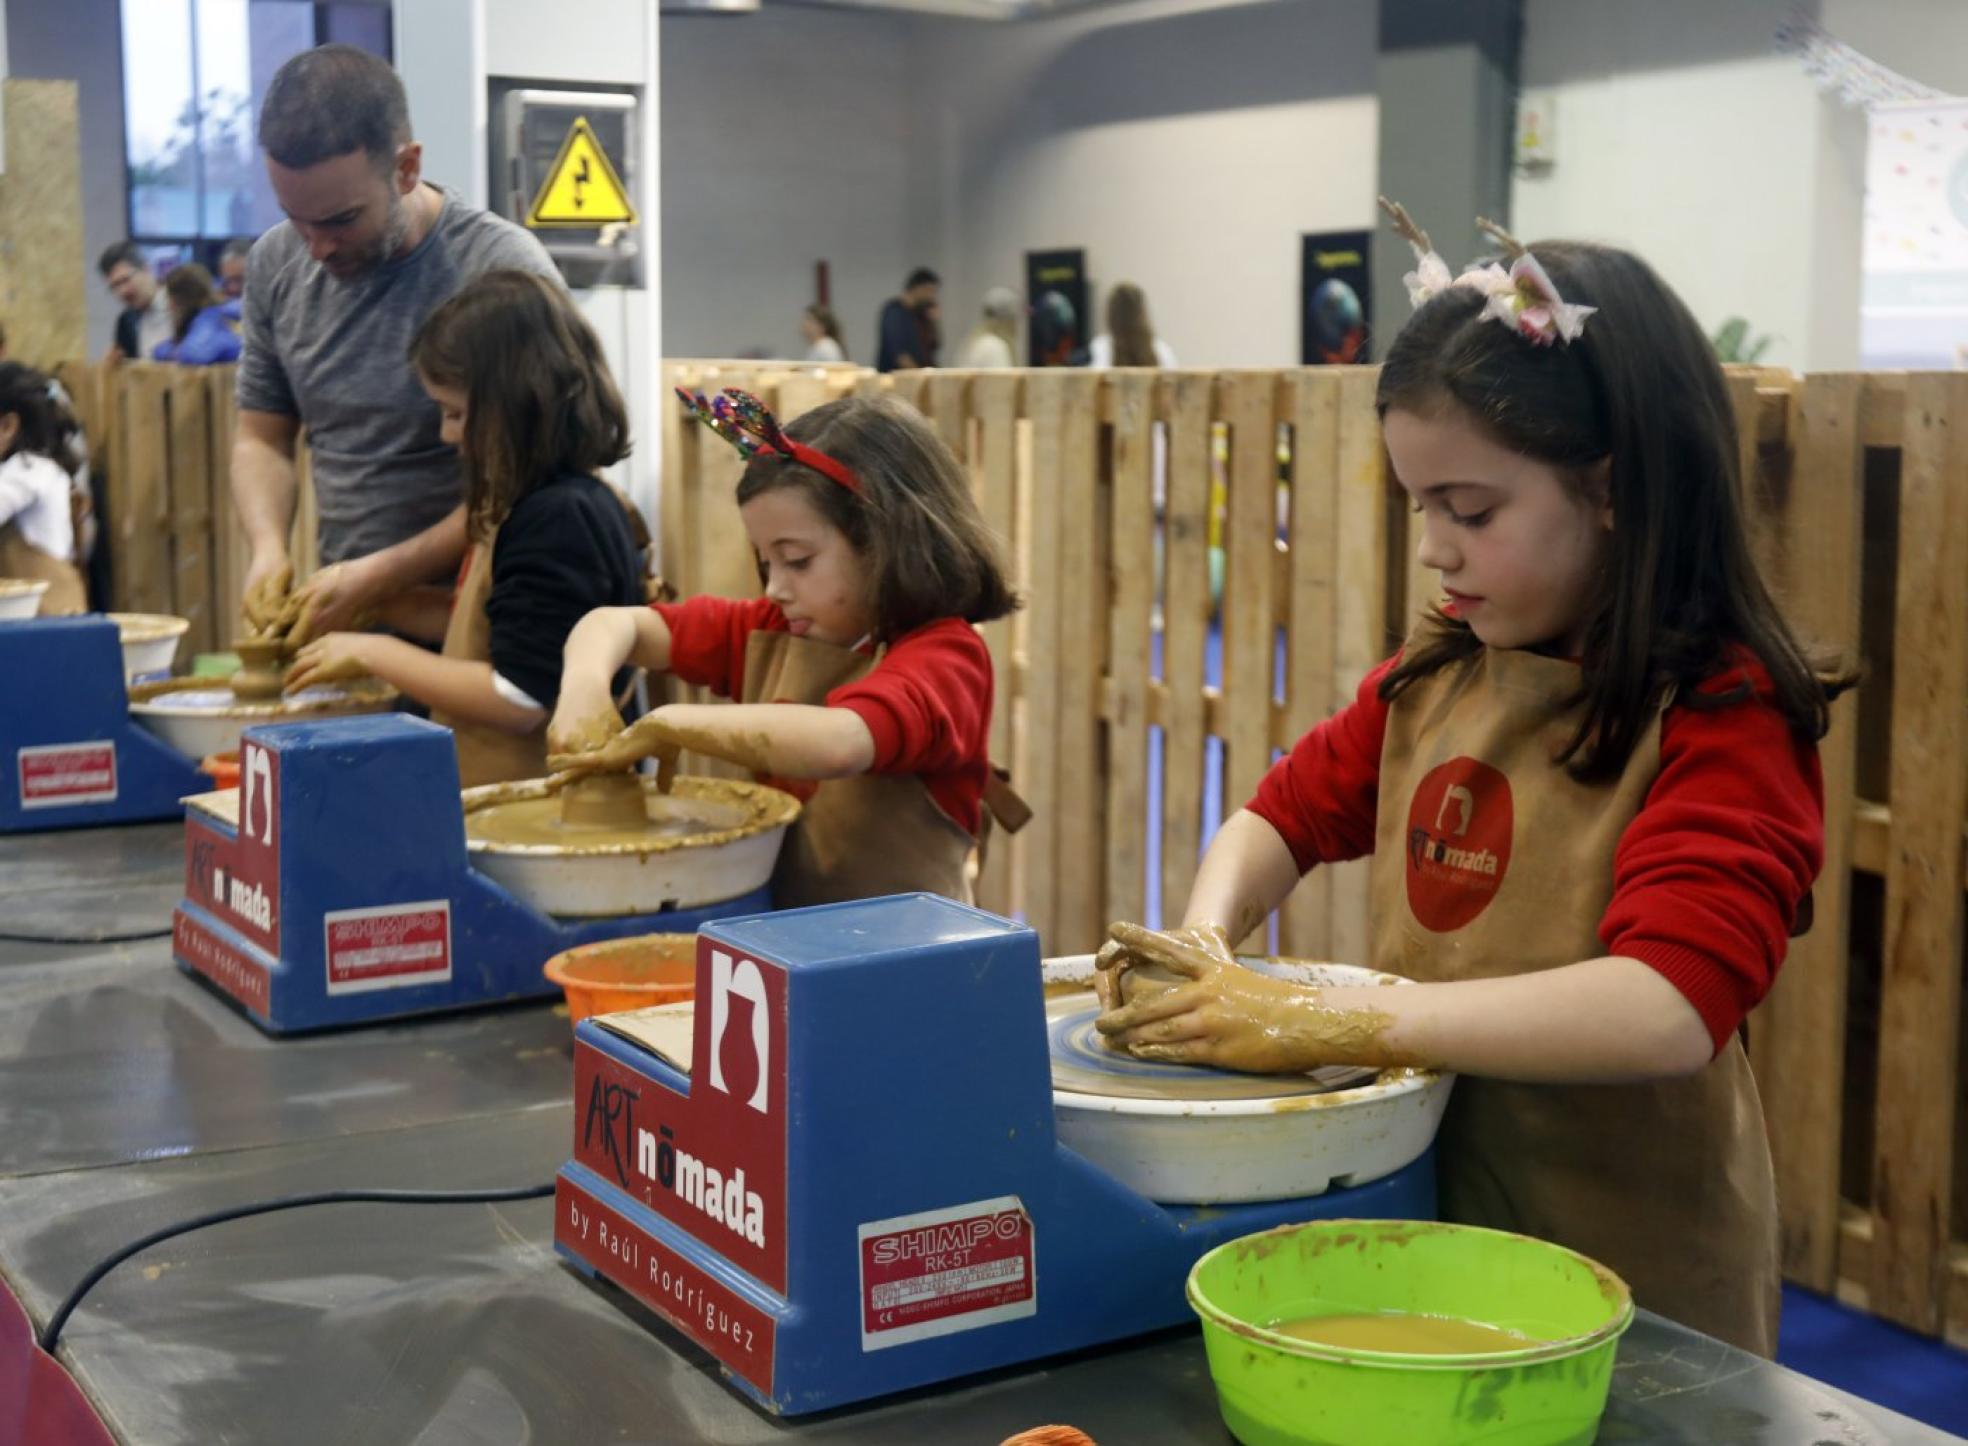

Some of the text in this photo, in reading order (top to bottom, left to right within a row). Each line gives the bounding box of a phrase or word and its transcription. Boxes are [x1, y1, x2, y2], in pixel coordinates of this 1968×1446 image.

[584, 1074, 641, 1190] ART
[571, 1201, 753, 1352] by Raúl Rodríguez
[872, 1213, 1021, 1264] SHIMPO
[925, 1250, 972, 1272] RK-5T
